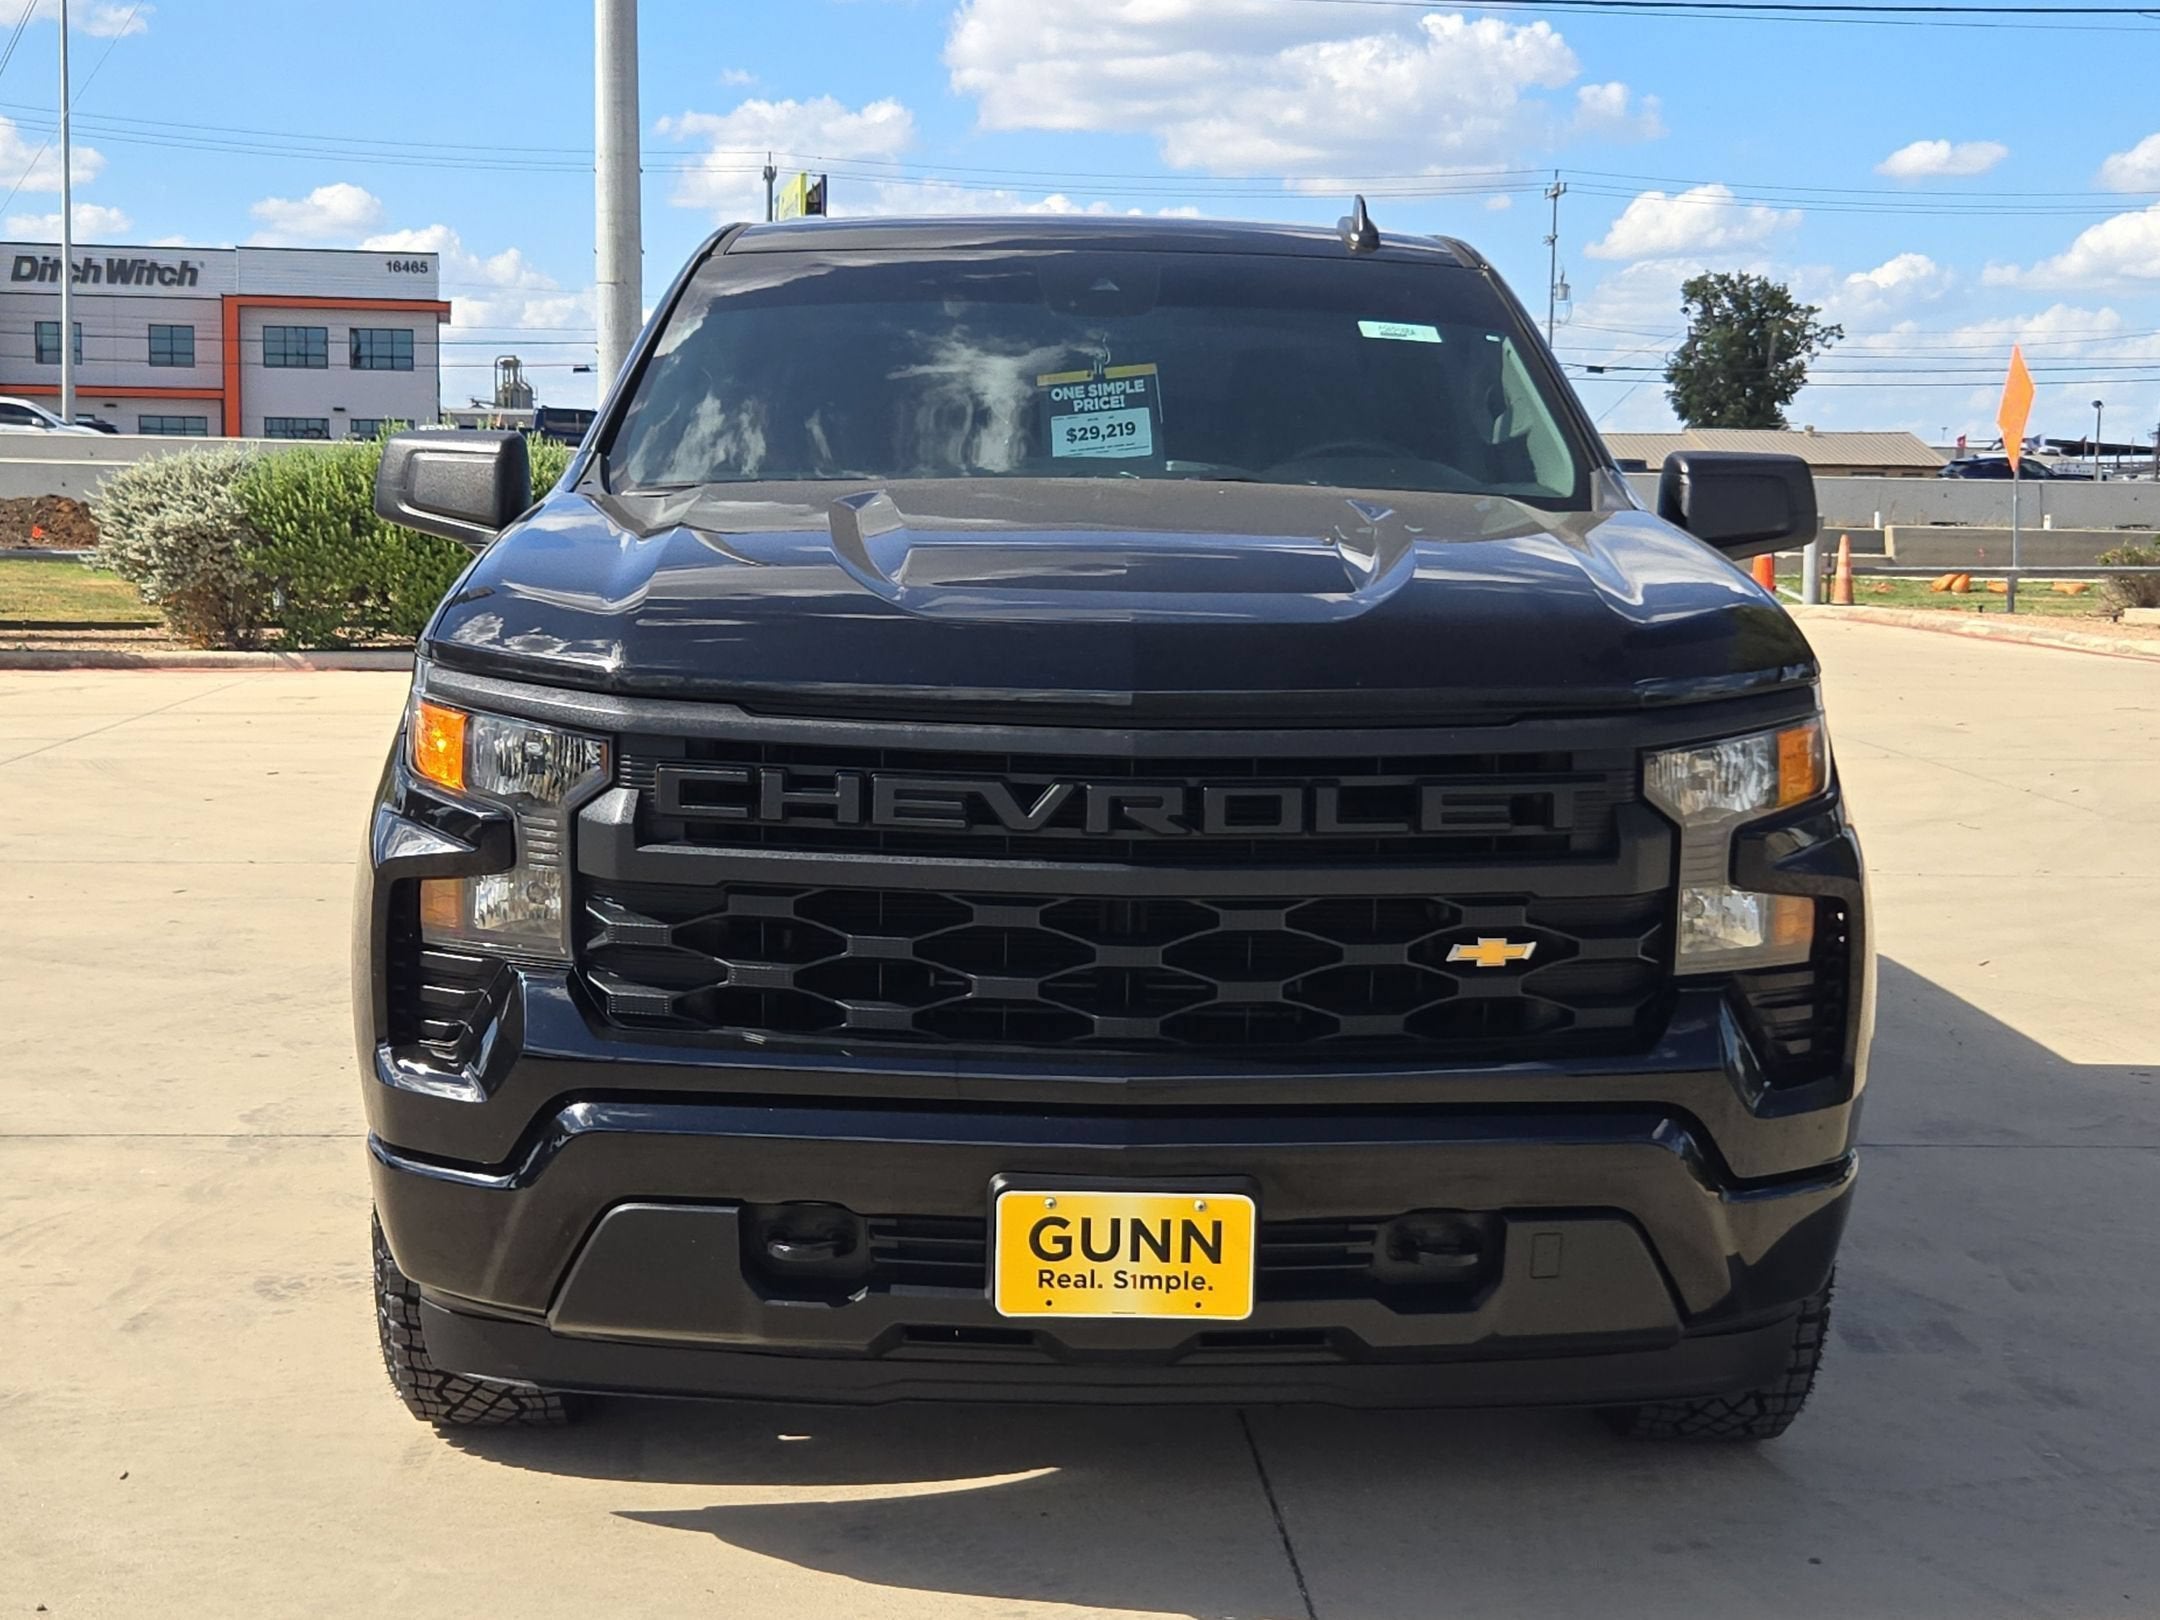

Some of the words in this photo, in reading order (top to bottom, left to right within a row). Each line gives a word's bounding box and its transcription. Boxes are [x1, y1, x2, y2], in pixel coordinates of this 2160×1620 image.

[11, 256, 102, 283] Ditch
[105, 258, 199, 287] Witch
[386, 260, 428, 274] 16465
[1051, 386, 1085, 401] ONE
[1088, 379, 1145, 398] SIMPLE
[1073, 395, 1125, 412] PRICE!
[1066, 421, 1136, 444] $29,219
[656, 762, 1606, 836] CHEVROLET
[1029, 1216, 1222, 1264] GUNN
[1038, 1269, 1103, 1289] Real.
